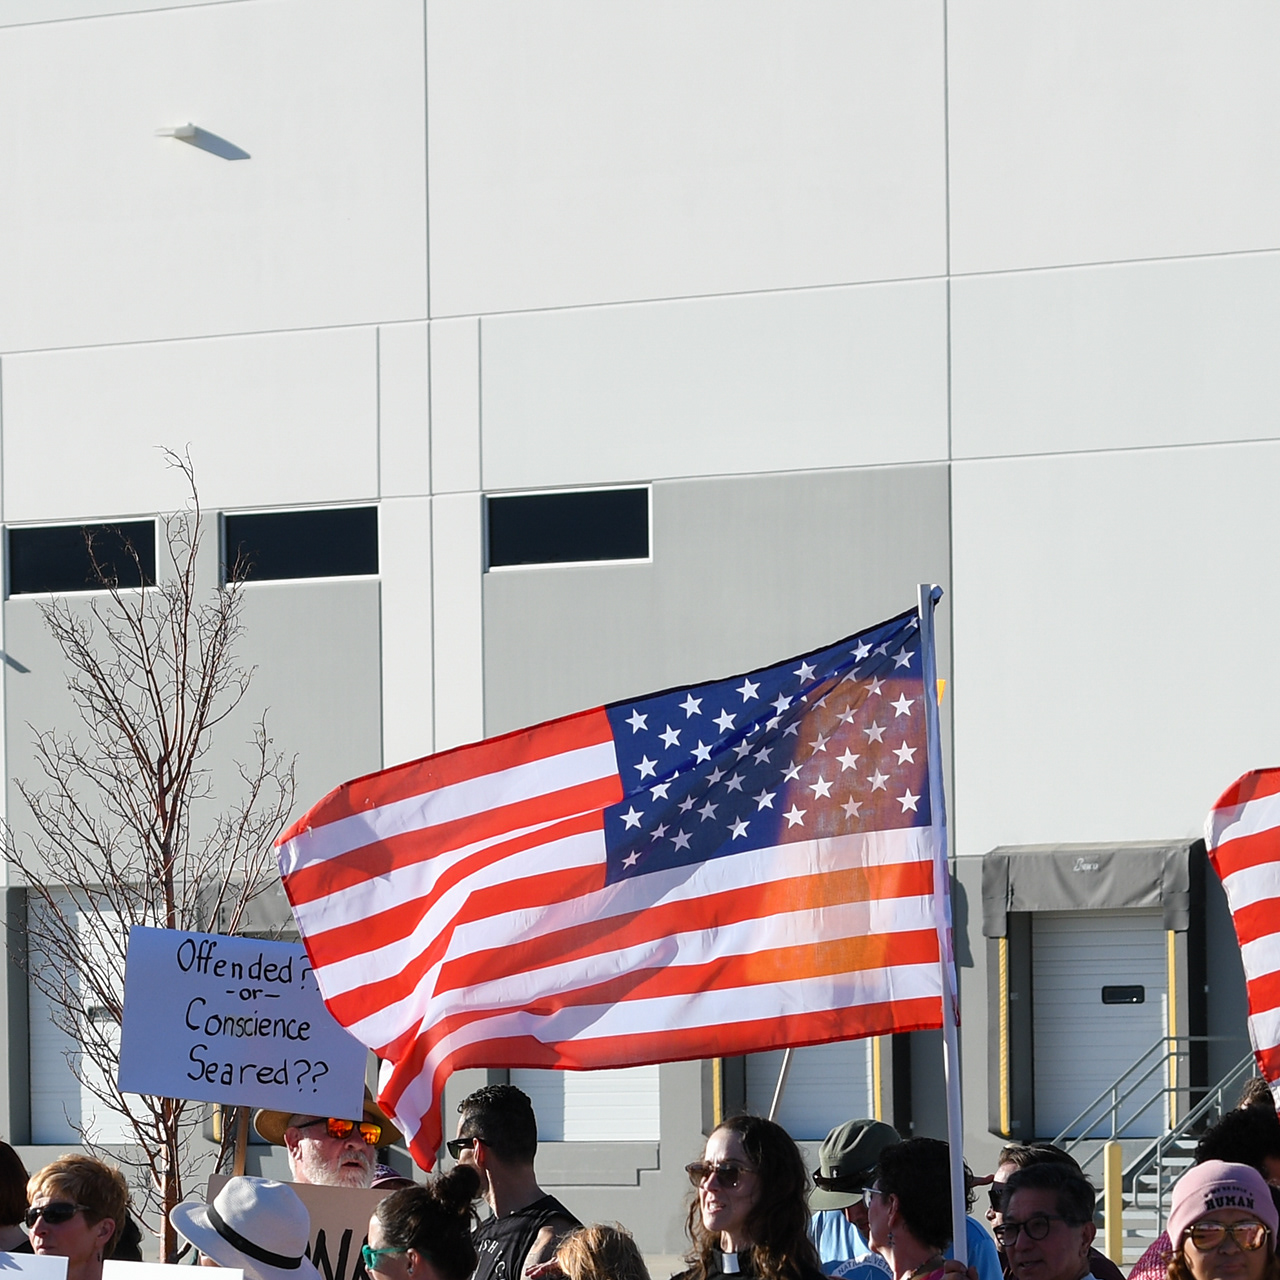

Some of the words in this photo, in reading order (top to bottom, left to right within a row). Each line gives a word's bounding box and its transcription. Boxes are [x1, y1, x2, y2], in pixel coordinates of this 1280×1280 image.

[185, 996, 311, 1042] Conscience
[186, 1043, 329, 1094] Seared??
[1205, 1195, 1254, 1211] HUMAN
